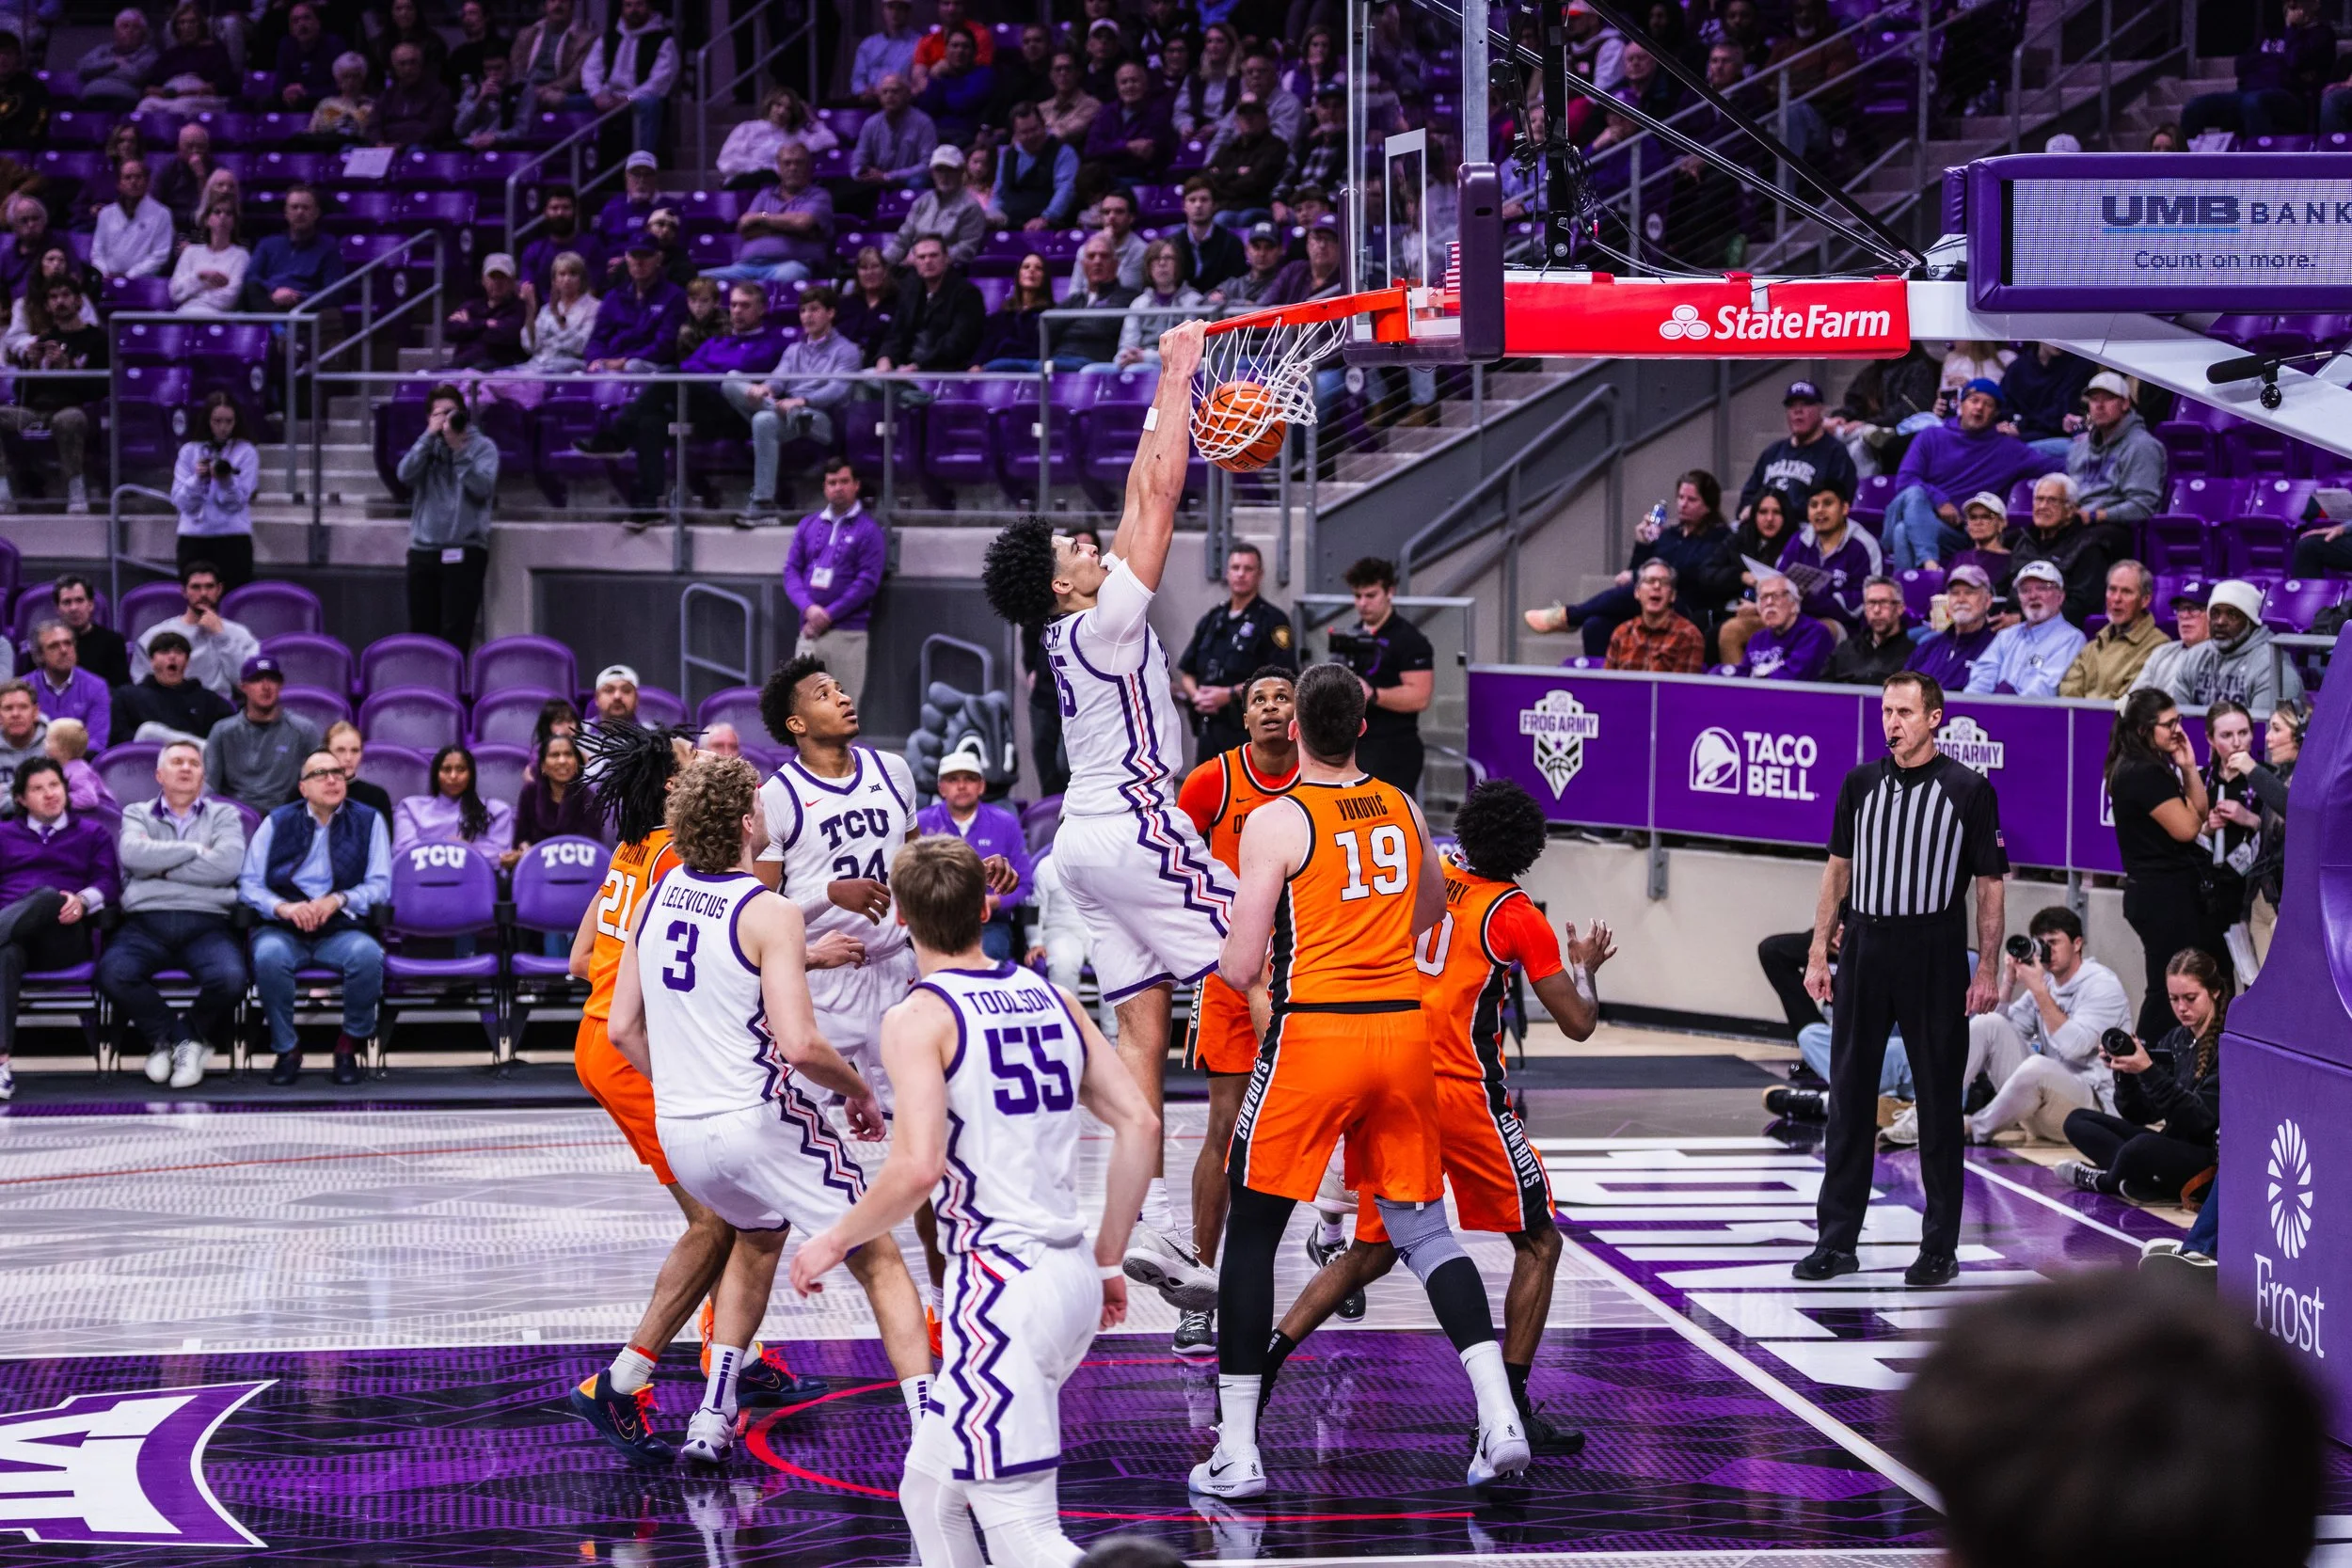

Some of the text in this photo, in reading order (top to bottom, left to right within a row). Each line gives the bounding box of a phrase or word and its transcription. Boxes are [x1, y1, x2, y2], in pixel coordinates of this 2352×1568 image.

[2102, 195, 2352, 227] UMB BANK
[2134, 249, 2316, 270] Count on more.
[1523, 713, 1597, 734] FROG ARMY
[1742, 731, 1819, 768] TACO
[1962, 744, 2001, 765] ARMY
[1746, 764, 1816, 801] BELL
[818, 808, 891, 851] TCU
[410, 844, 468, 872] TCU
[540, 842, 597, 868] TCU
[1333, 823, 1409, 903] 19
[596, 867, 638, 944] 21
[661, 885, 728, 920] LELEVICIUS
[661, 919, 700, 993] 3
[961, 987, 1056, 1016] TOOLSON
[983, 1023, 1074, 1117] 55
[1235, 1057, 1270, 1141] COWBOYS
[1499, 1111, 1541, 1189] COWBOYS
[2253, 1252, 2325, 1359] Frost
